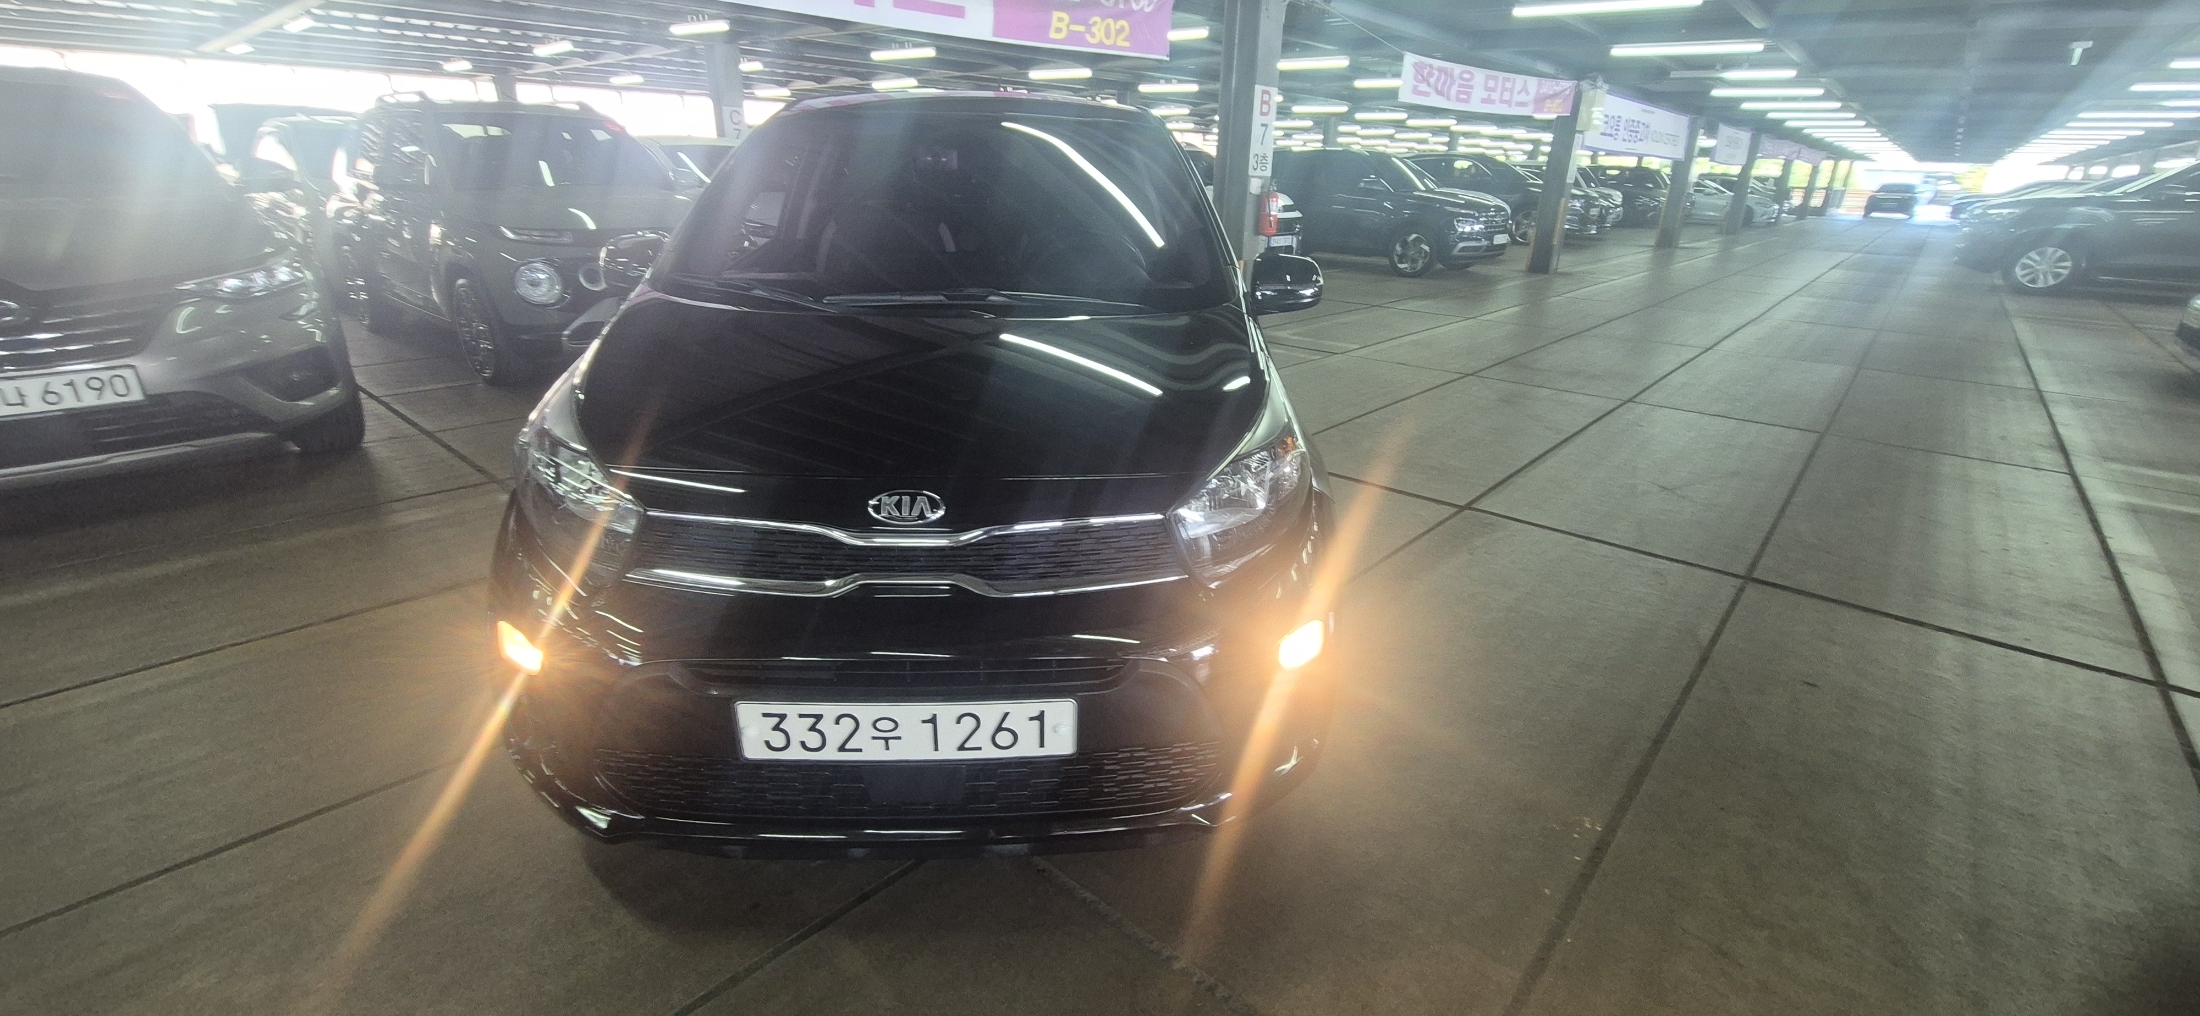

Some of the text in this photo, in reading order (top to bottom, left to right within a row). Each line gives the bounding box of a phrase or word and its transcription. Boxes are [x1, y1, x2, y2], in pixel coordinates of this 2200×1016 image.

[1048, 11, 1130, 47] B-302
[1411, 60, 1531, 108] 한마음 모터스
[1259, 89, 1272, 117] B
[729, 109, 742, 126] C
[1260, 122, 1269, 146] 7
[1252, 152, 1269, 172] 3층
[41, 374, 131, 406] 6190
[880, 495, 932, 518] KIA
[761, 709, 1046, 753] 332우 1261
